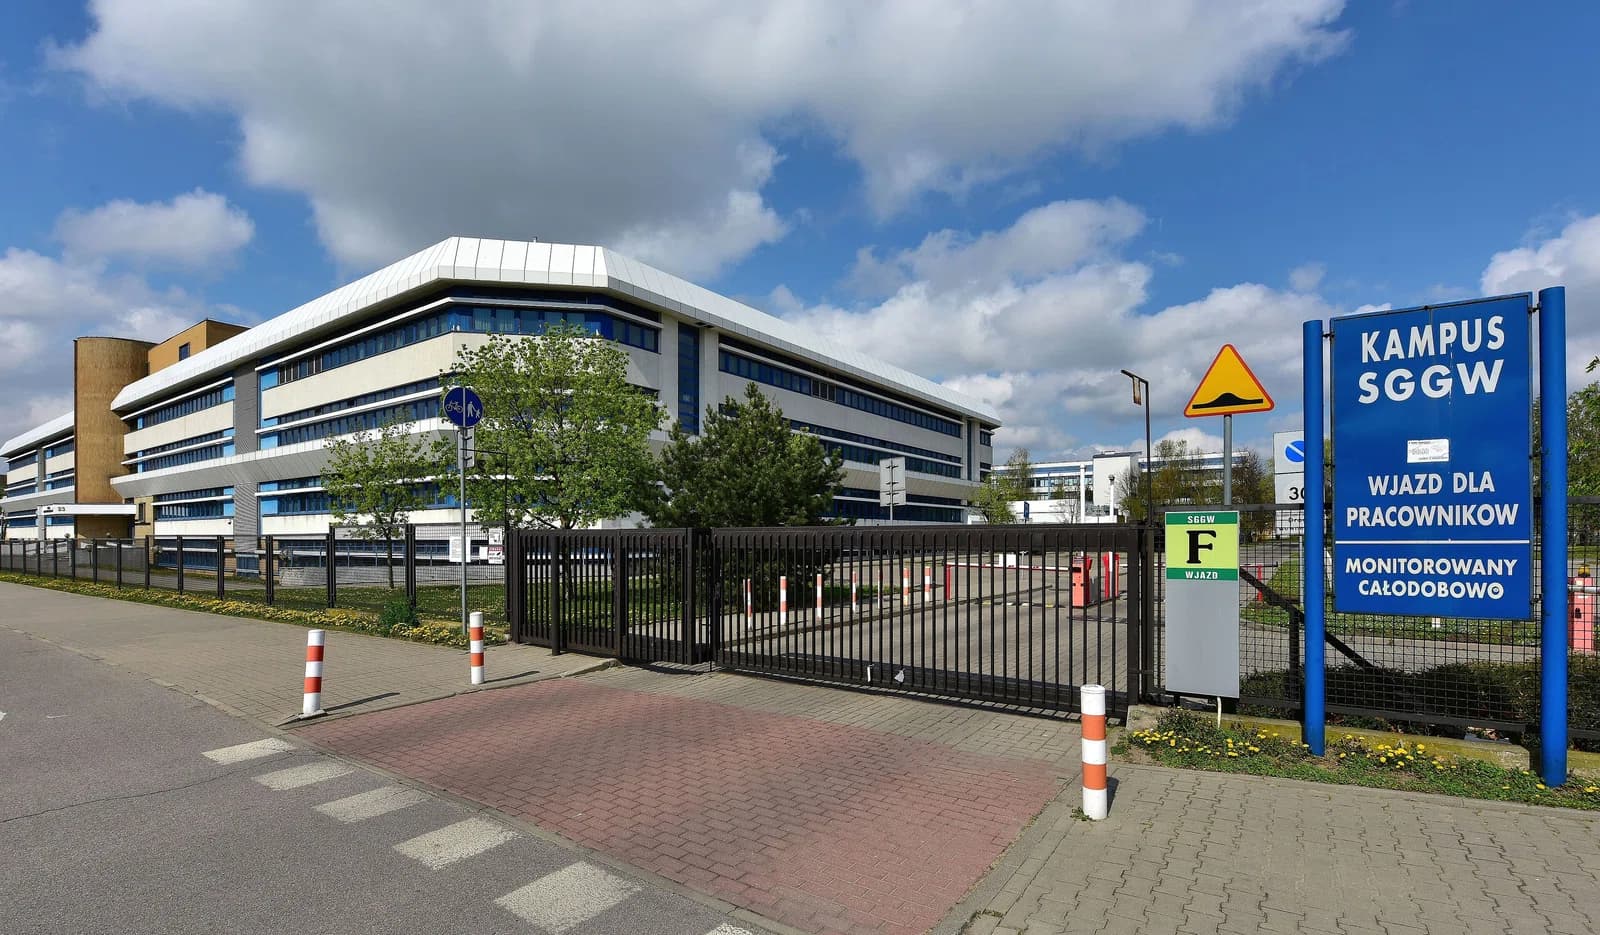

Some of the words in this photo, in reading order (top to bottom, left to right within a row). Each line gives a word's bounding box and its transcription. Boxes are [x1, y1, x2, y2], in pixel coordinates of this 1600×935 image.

[1361, 315, 1505, 363] KAMPUS
[1358, 359, 1504, 404] SGGW
[1368, 473, 1443, 496] WJAZD
[1453, 472, 1495, 493] DLA
[1187, 515, 1215, 524] SGGW
[1346, 504, 1519, 527] PRACOWNIKOW
[1186, 530, 1217, 564] F
[1185, 571, 1218, 580] WJAZD
[1345, 558, 1518, 576] MONITOROWANY
[1358, 580, 1504, 600] CAŁODOBOWO
